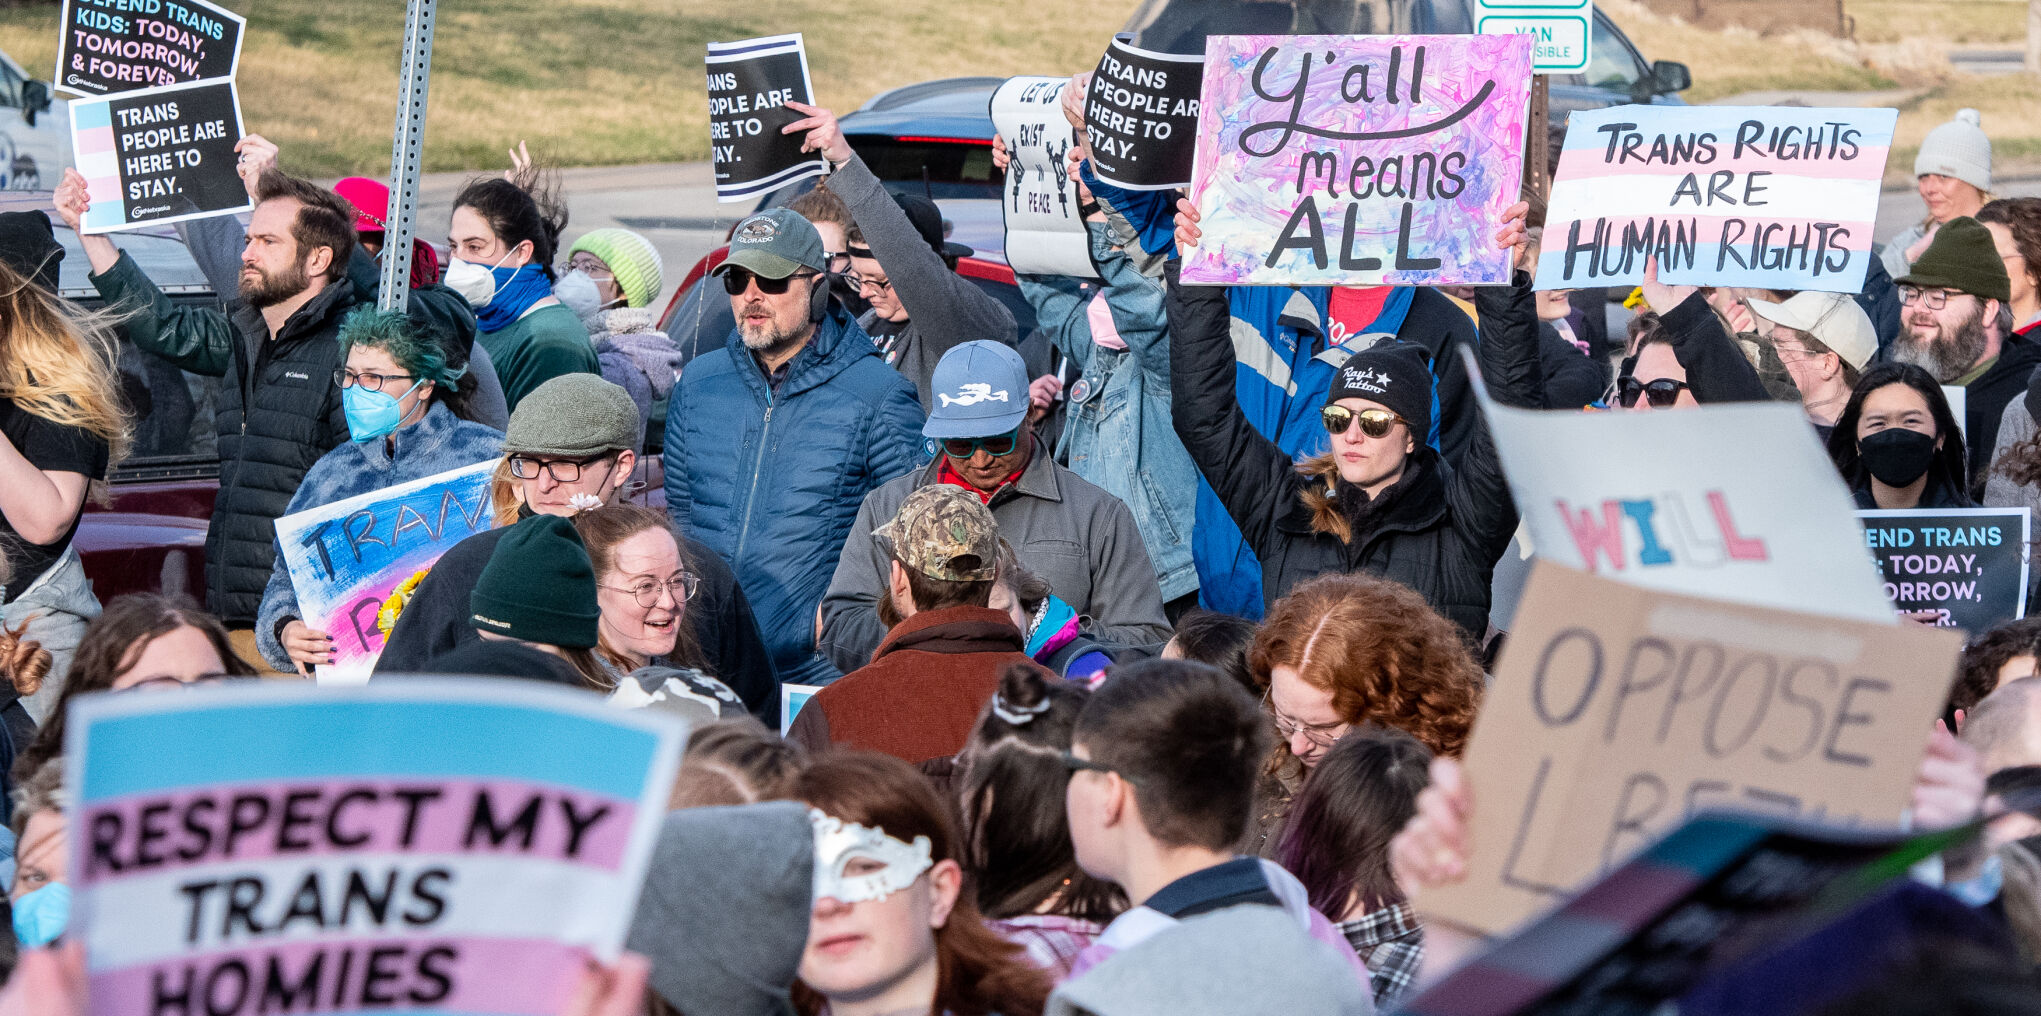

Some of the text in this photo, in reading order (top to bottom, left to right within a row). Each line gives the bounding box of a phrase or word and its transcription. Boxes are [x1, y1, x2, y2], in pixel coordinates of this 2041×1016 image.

[76, 7, 206, 60] KIDS: TODAY,
[166, 2, 224, 40] TRANS
[71, 53, 85, 72] &
[74, 30, 201, 80] TOMORROW,
[1536, 46, 1571, 58] SIBLE
[1101, 52, 1168, 89] TRANS
[708, 88, 794, 116] EOPLE ARE
[1020, 82, 1066, 104] LET US
[1094, 76, 1200, 117] PEOPLE AR
[117, 102, 180, 127] TRANS
[711, 118, 763, 139] ERE TO
[1089, 100, 1172, 140] HERE TO
[122, 120, 227, 151] PEOPLE ARE
[1020, 124, 1046, 147] EXIST
[1086, 124, 1137, 161] STAY.
[1598, 119, 1862, 165] TRANS RIGHTS
[126, 148, 202, 176] HERE TO
[712, 145, 742, 163] TAY.
[129, 176, 183, 200] STAY.
[1296, 150, 1466, 200] means
[1669, 170, 1773, 207] ARE
[1028, 192, 1051, 214] PEACE
[737, 236, 774, 244] COLORADO
[1265, 196, 1442, 271] ALL
[1563, 217, 1851, 281] HUMAN RIGHTS
[1342, 366, 1373, 379] Ray's
[1343, 378, 1387, 394] Tattoo
[301, 481, 491, 582] TRAN
[1555, 490, 1769, 573] WILL
[1866, 526, 2002, 548] END TRANS
[1889, 554, 1983, 577] TODAY,
[1883, 581, 1982, 603] ORROW,
[1531, 626, 1891, 767] OPPOSE
[86, 784, 611, 874] RESPECT MY
[179, 865, 455, 942] TRANS
[148, 945, 458, 1016] HOMIES
